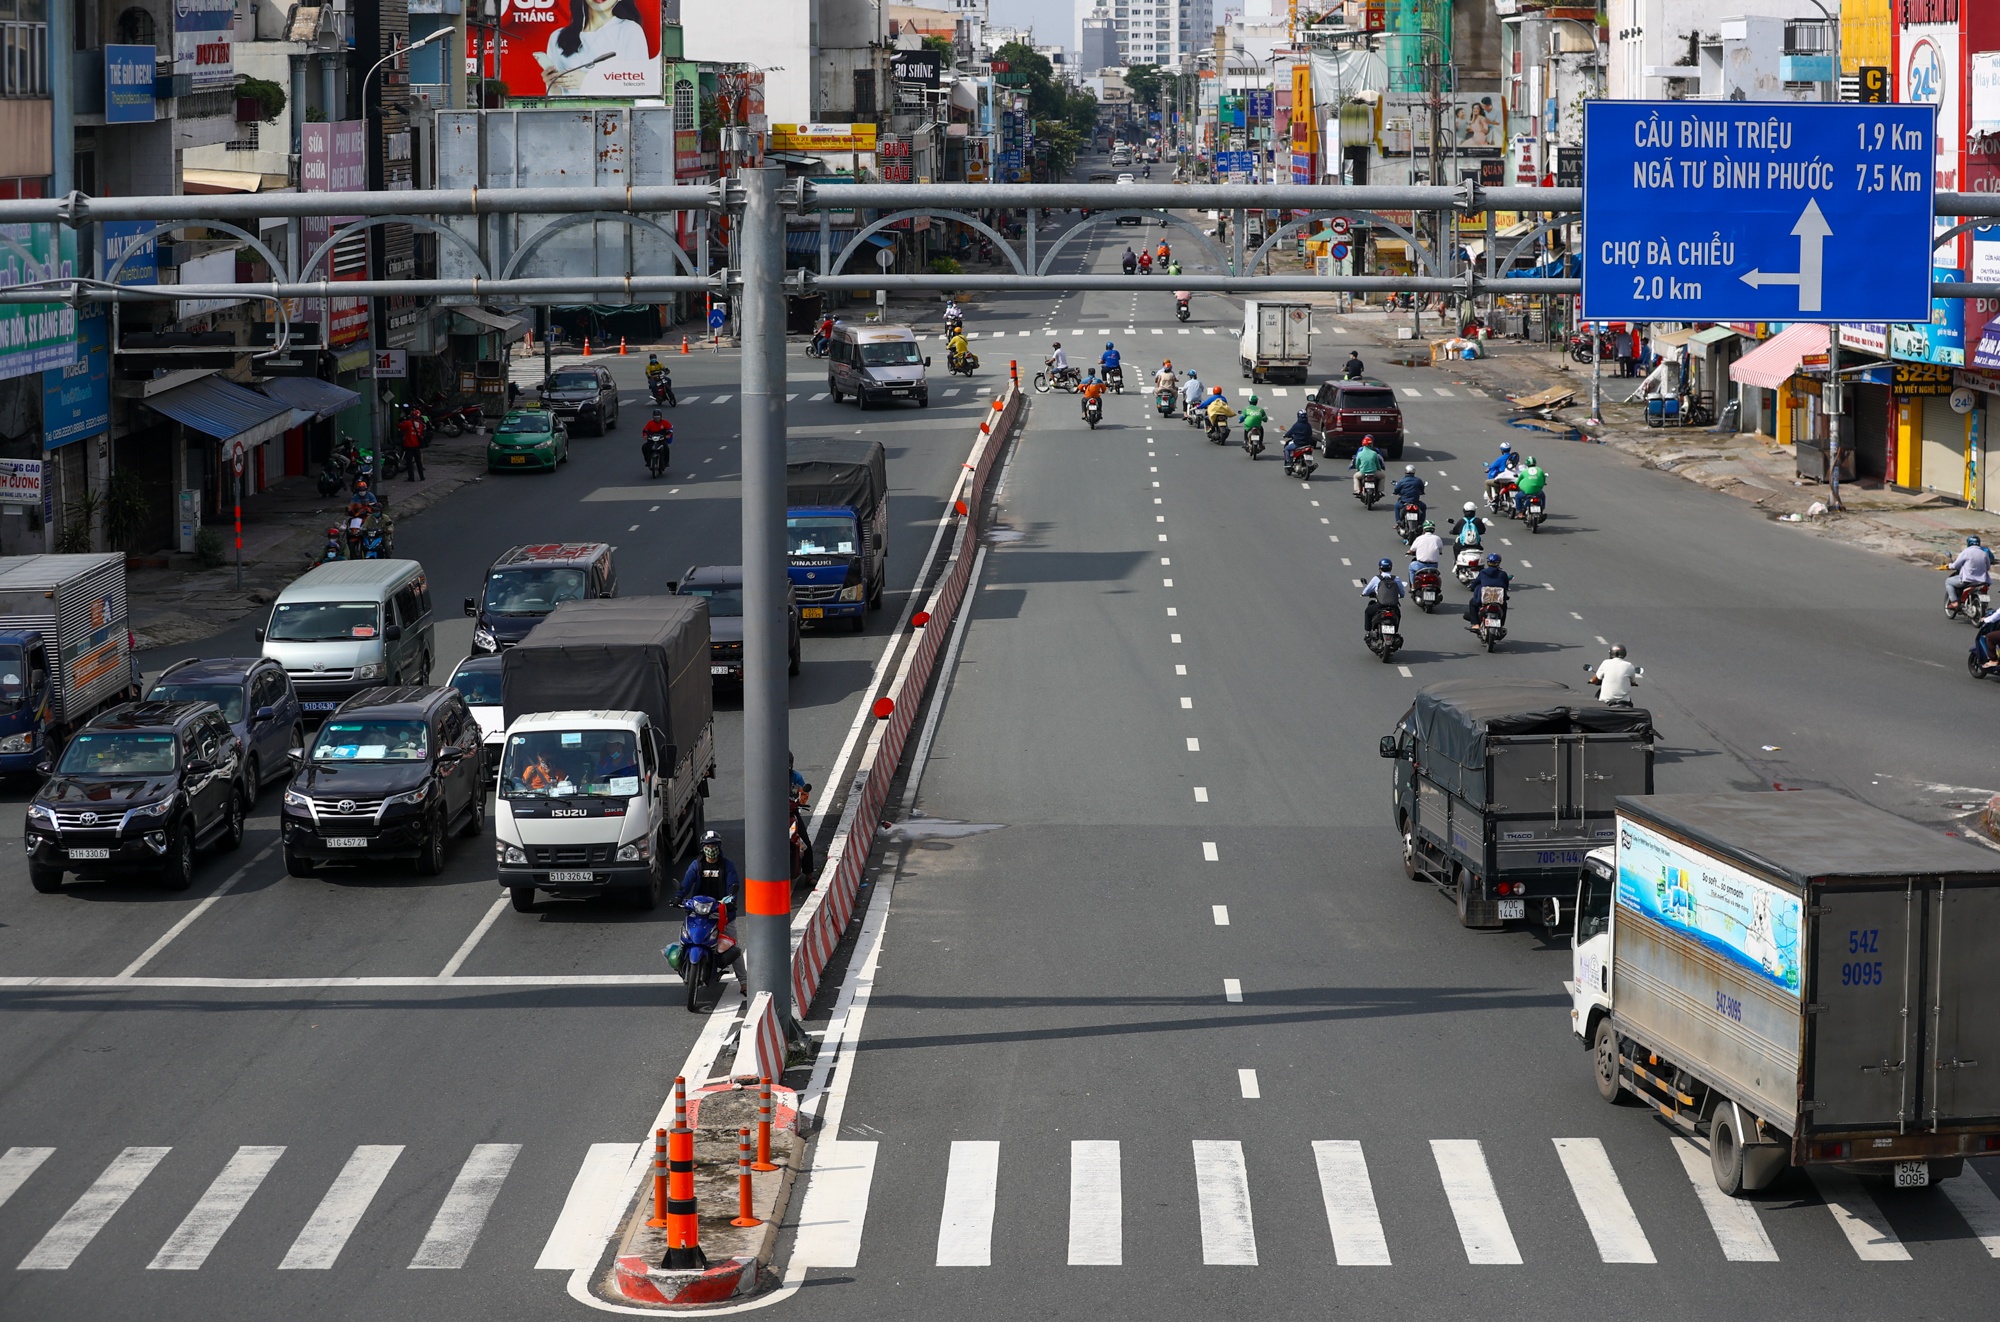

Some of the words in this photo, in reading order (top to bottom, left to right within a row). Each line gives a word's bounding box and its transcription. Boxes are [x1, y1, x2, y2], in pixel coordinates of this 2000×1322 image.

[513, 10, 555, 23] THÁNG
[110, 57, 122, 85] THẾ
[135, 64, 153, 84] DECAL
[604, 71, 645, 81] viettel
[1416, 114, 1426, 122] 28
[308, 131, 323, 153] SỬA
[1634, 110, 1673, 149] CẦU
[1680, 115, 1728, 149] BÌNH
[1735, 116, 1792, 154] TRIỆU
[1857, 122, 1884, 152] 1,9
[1891, 123, 1923, 151] Km
[335, 132, 350, 159] PHỤ
[884, 138, 909, 157] BÚN
[305, 159, 326, 180] CHỮA
[332, 162, 348, 189] ĐIỆN
[884, 162, 909, 183] ĐẬU
[1483, 163, 1503, 177] QUÁN
[1634, 157, 1674, 189] NGÃ
[1680, 161, 1709, 189] TƯ
[1713, 156, 1760, 190] BÌNH
[1768, 155, 1834, 191] PHƯỚC
[1856, 164, 1884, 193] 7,5
[1890, 165, 1922, 192] Km
[107, 232, 123, 260] MÁY
[1602, 240, 1641, 270] CHỢ
[1647, 236, 1673, 266] BÀ
[1678, 231, 1735, 266] CHIỂU
[1633, 276, 1663, 302] 2,0
[1670, 275, 1702, 300] km
[28, 318, 38, 342] SX
[38, 305, 58, 339] BẢNG
[1904, 383, 1918, 394] VIẾT
[1918, 383, 1936, 395] NGHỆ
[25, 462, 40, 474] CÁO
[10, 474, 40, 489] CƯỜNG
[551, 809, 587, 817] ISUZU
[1726, 885, 1744, 899] smooth
[1503, 901, 1519, 909] 70C
[1849, 929, 1879, 954] 54Z
[1841, 961, 1883, 987] 9095
[1716, 990, 1742, 1022] 54Z-9095
[1901, 1161, 1922, 1174] 54Z
[1898, 1174, 1926, 1186] 9095
